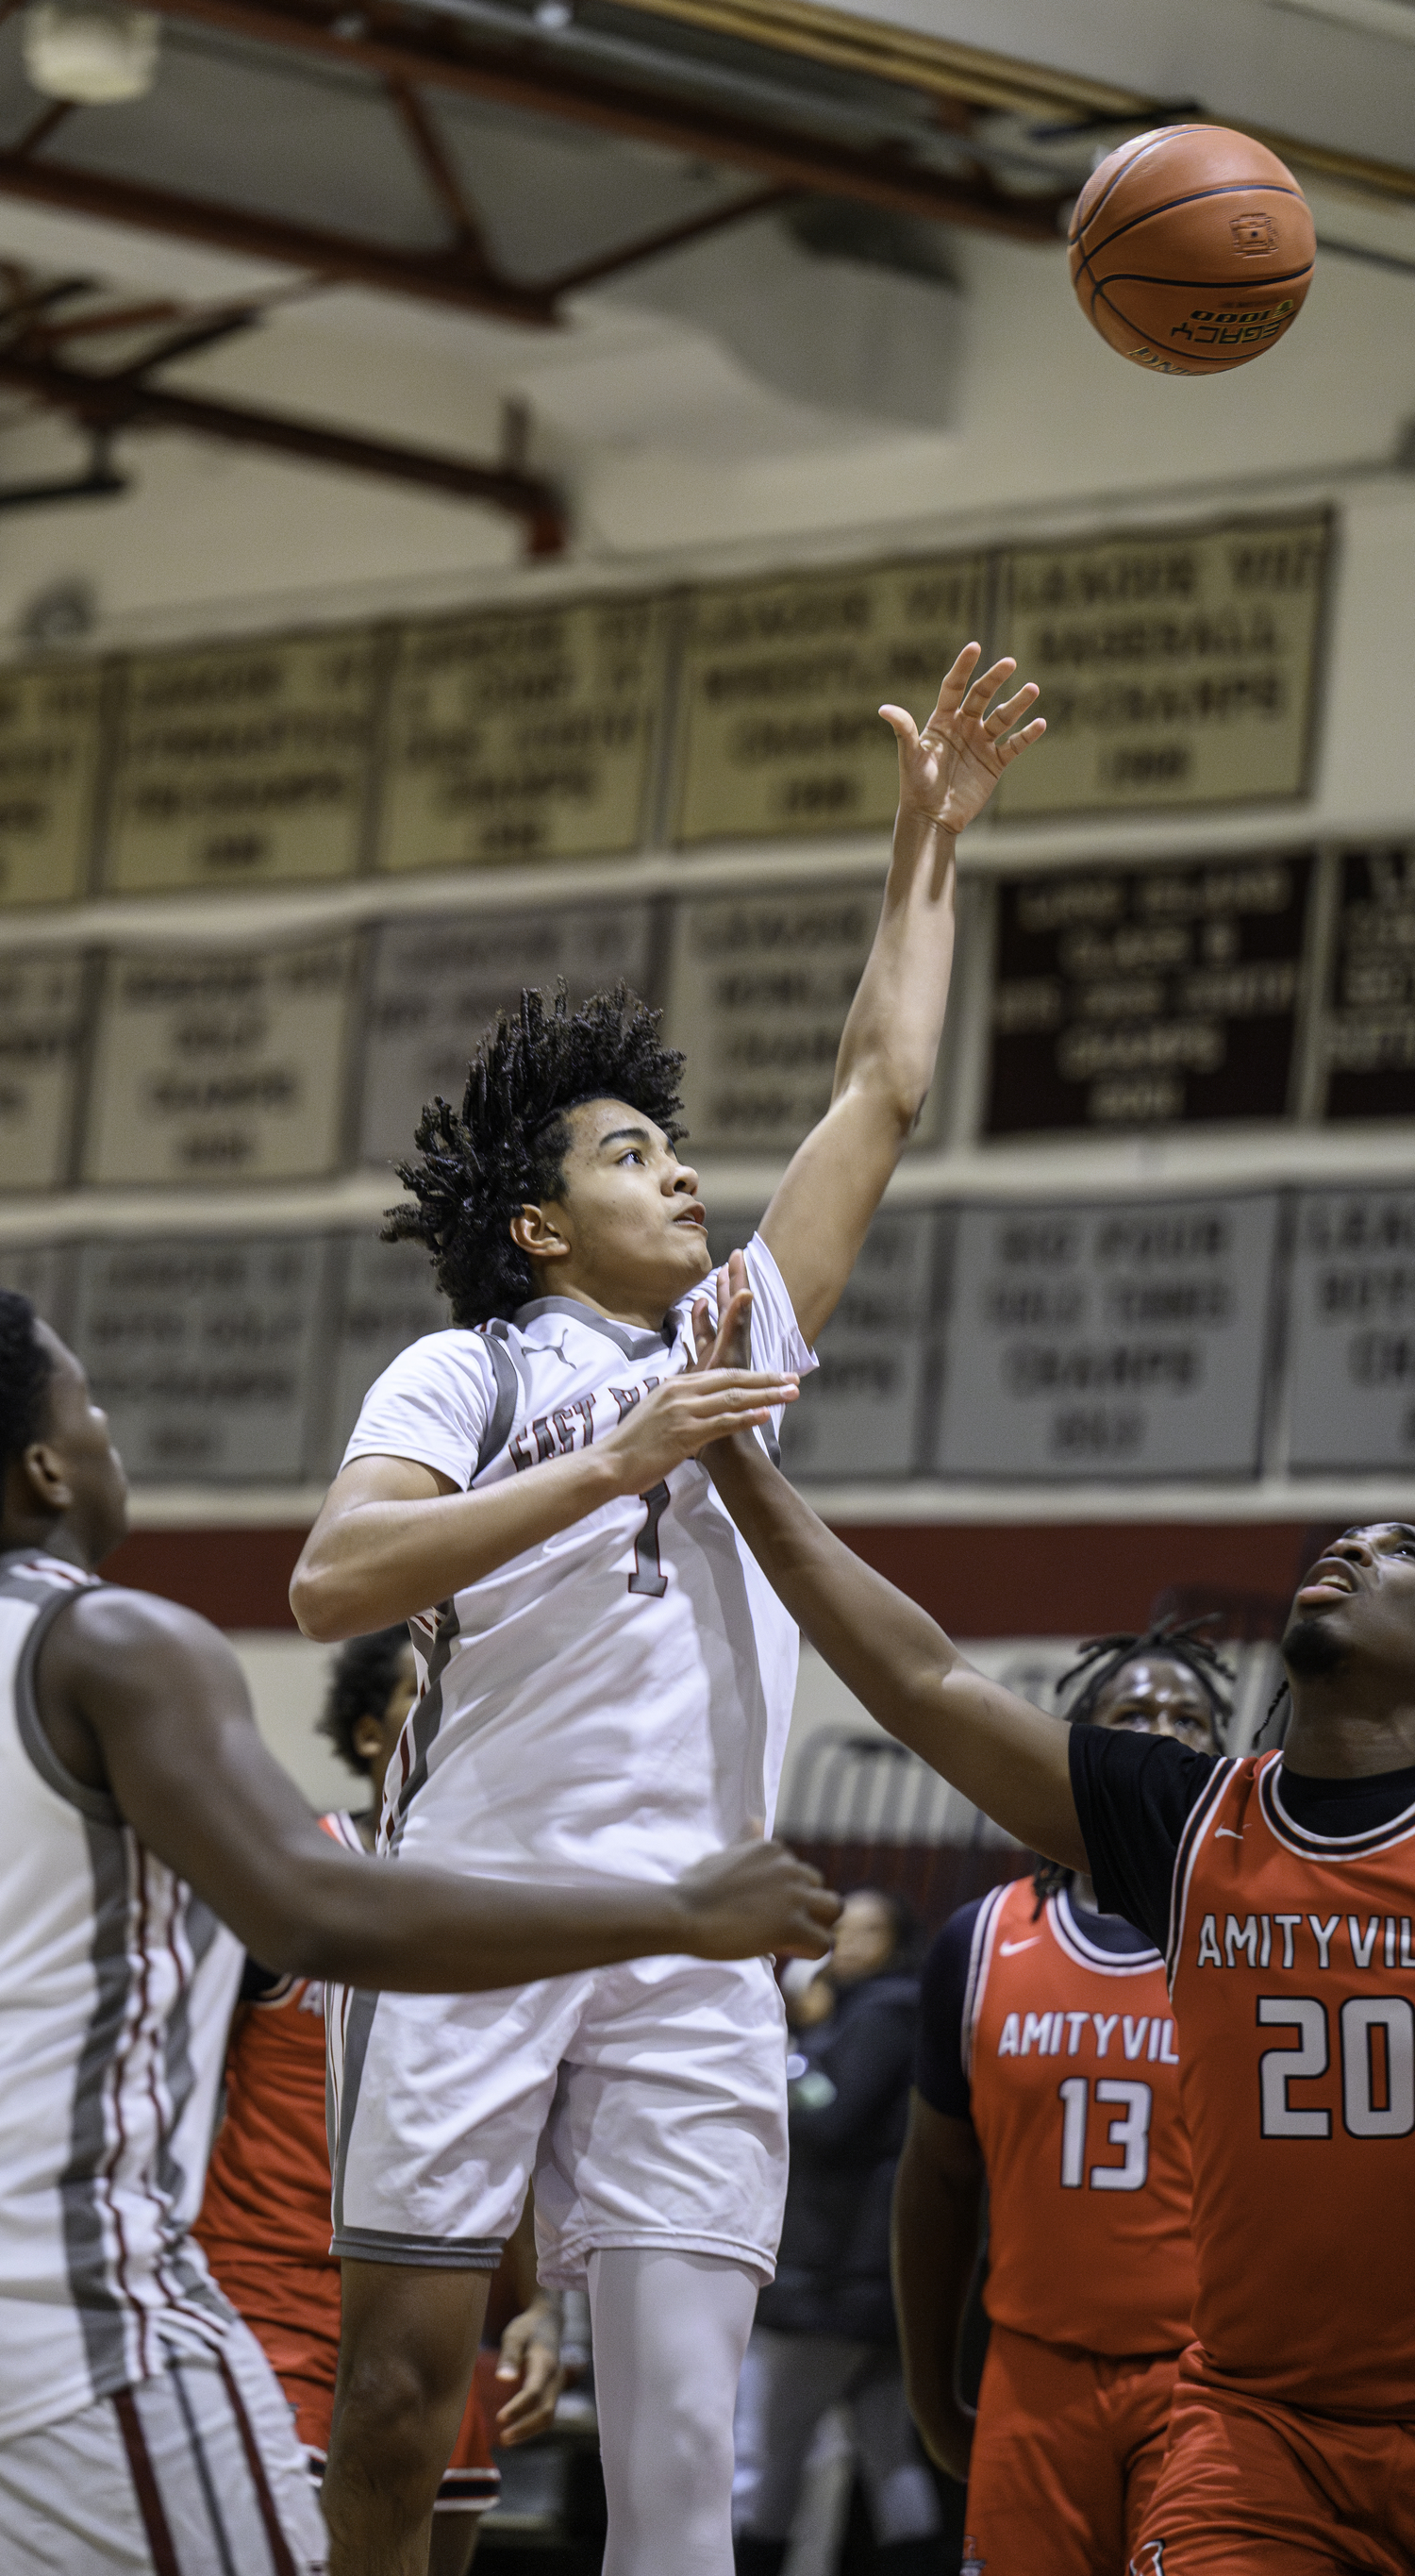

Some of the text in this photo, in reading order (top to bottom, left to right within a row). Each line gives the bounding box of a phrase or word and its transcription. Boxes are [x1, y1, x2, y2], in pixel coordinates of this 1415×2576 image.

[508, 1393, 596, 1473] EAST
[627, 1478, 672, 1598] 1
[1256, 1994, 1415, 2140] 20
[1058, 2075, 1153, 2192] 13
